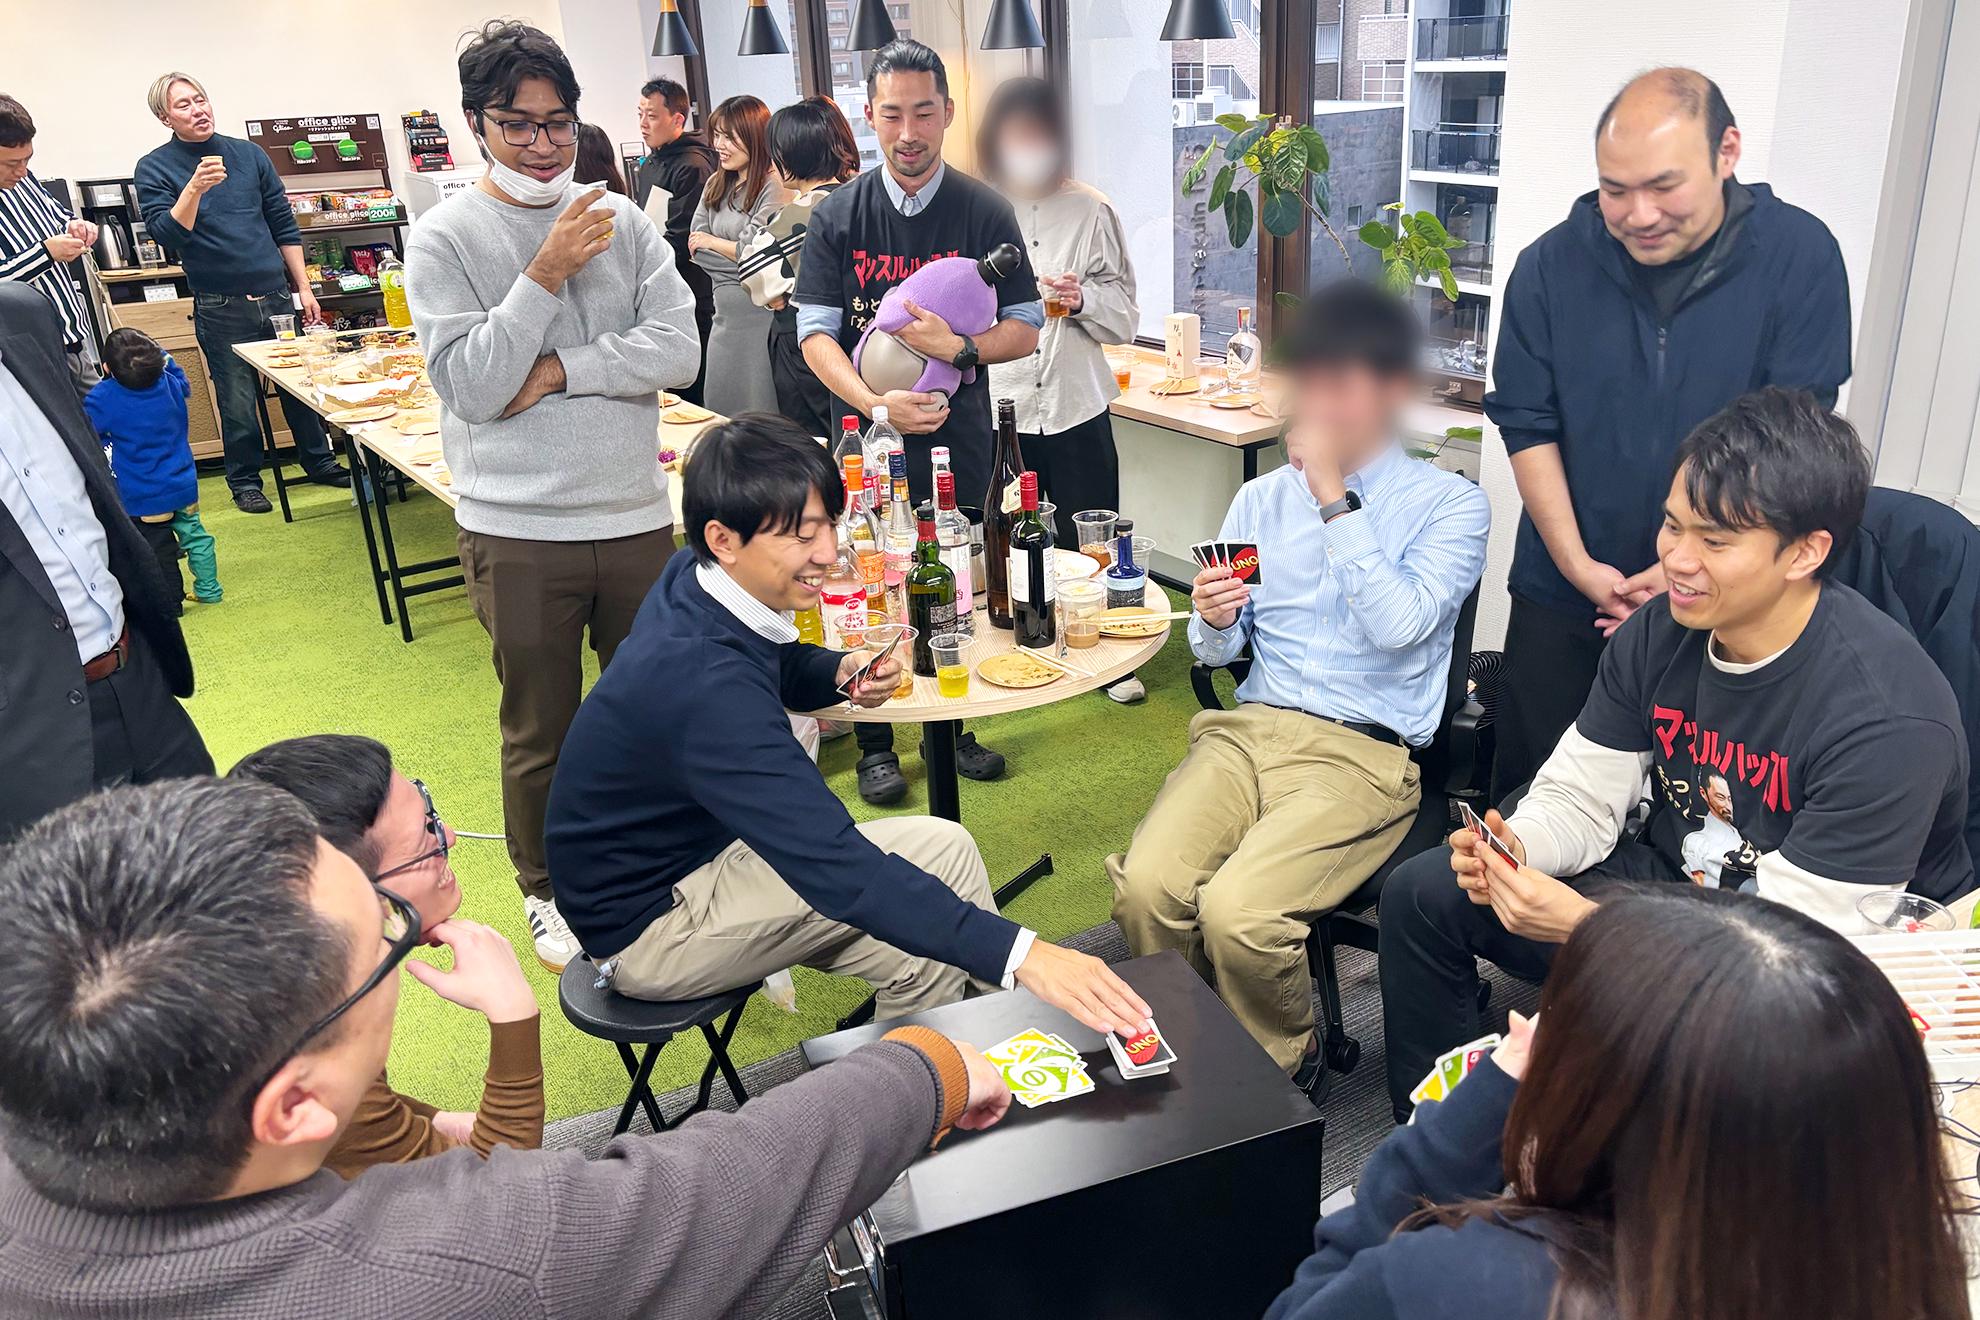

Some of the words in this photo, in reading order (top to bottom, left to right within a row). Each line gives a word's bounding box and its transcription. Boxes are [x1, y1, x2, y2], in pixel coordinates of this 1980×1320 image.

[298, 116, 329, 127] office
[331, 115, 357, 126] glico
[325, 211, 348, 220] office
[1230, 555, 1259, 571] UNO
[1125, 1034, 1159, 1055] UNO
